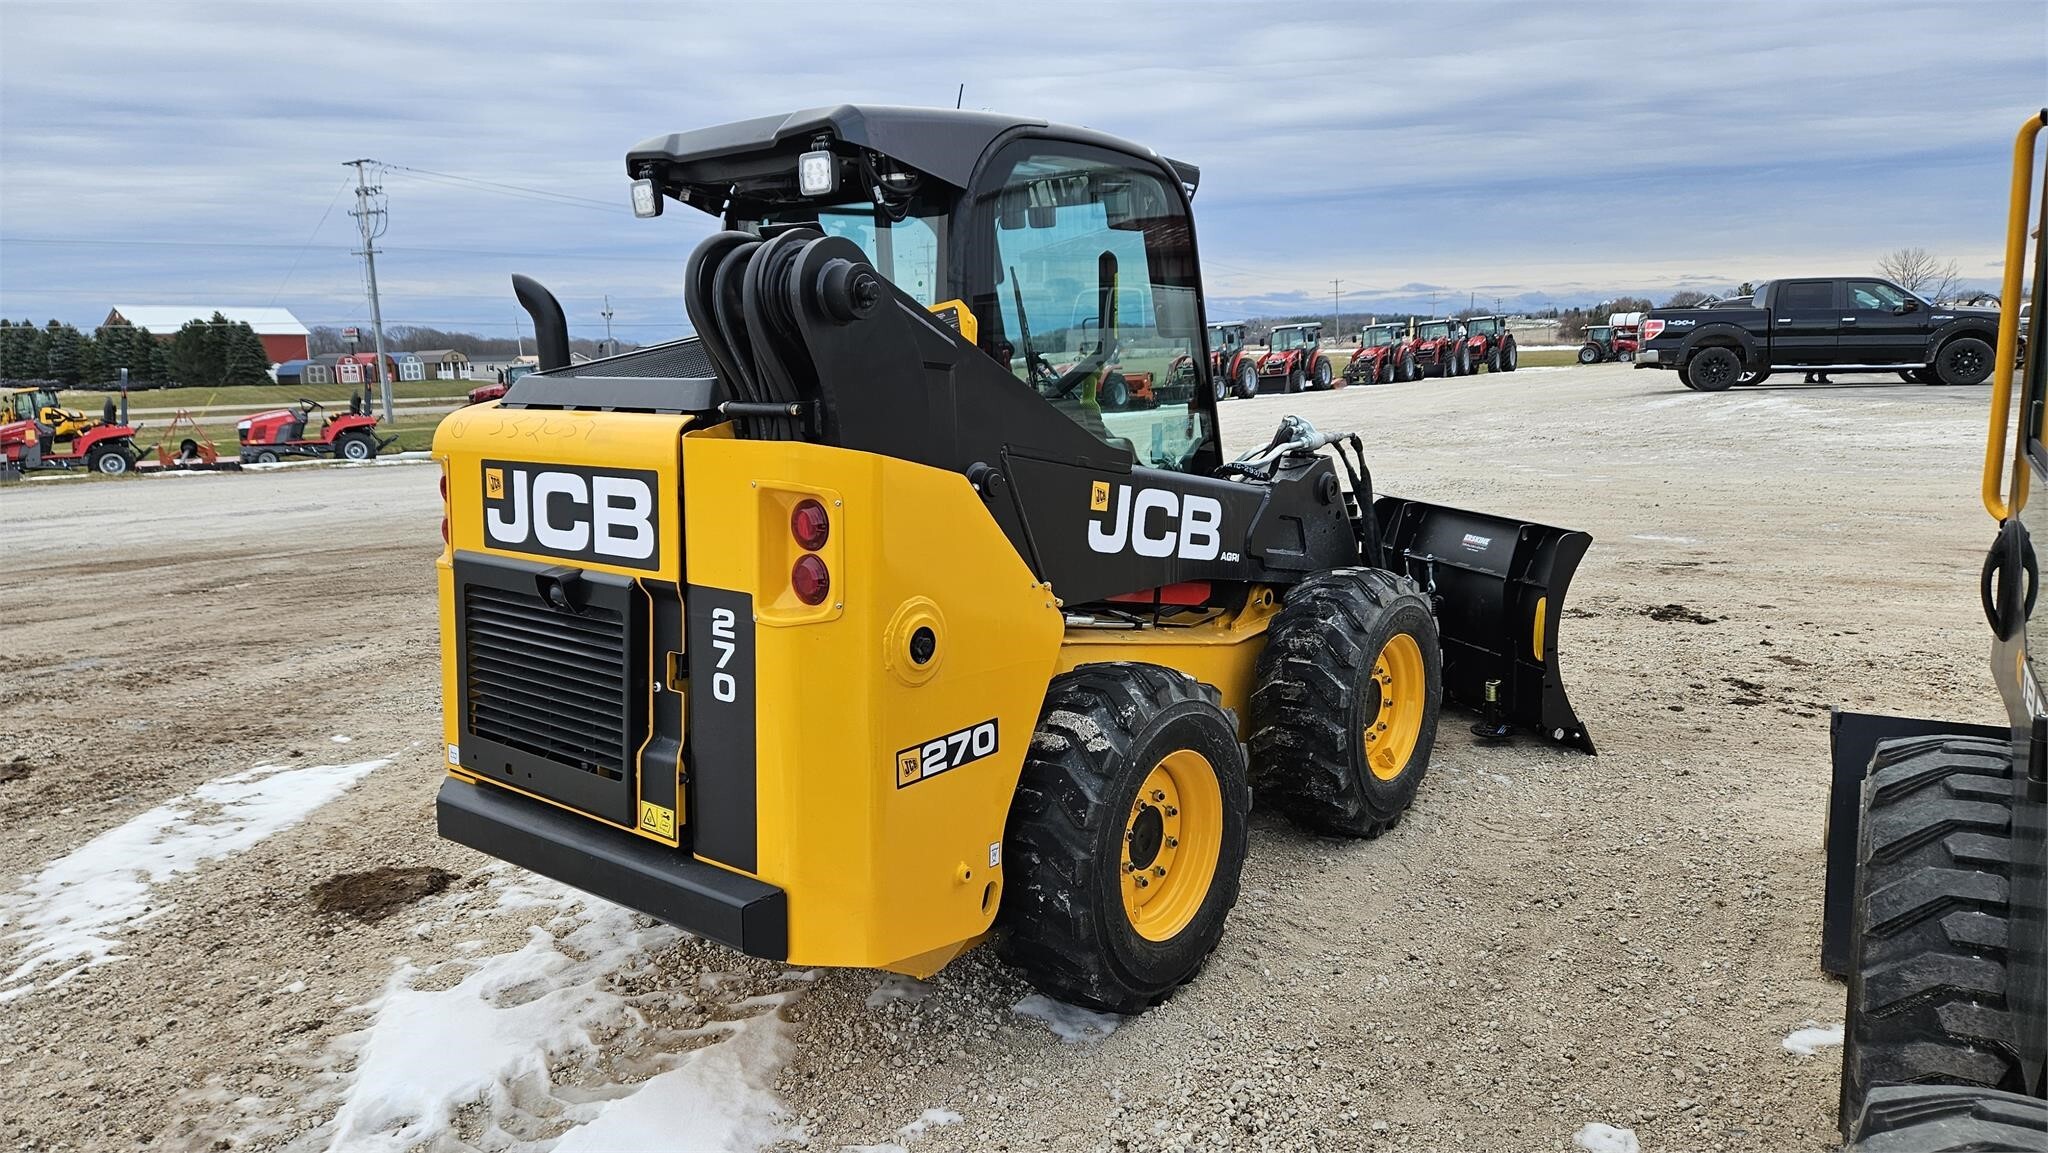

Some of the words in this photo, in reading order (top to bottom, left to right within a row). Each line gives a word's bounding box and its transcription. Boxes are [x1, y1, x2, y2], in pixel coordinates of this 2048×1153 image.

[487, 470, 654, 559] JCB
[1088, 484, 1222, 561] JCB
[1220, 552, 1240, 563] AGRI
[712, 607, 736, 703] 270
[922, 723, 995, 777] 270
